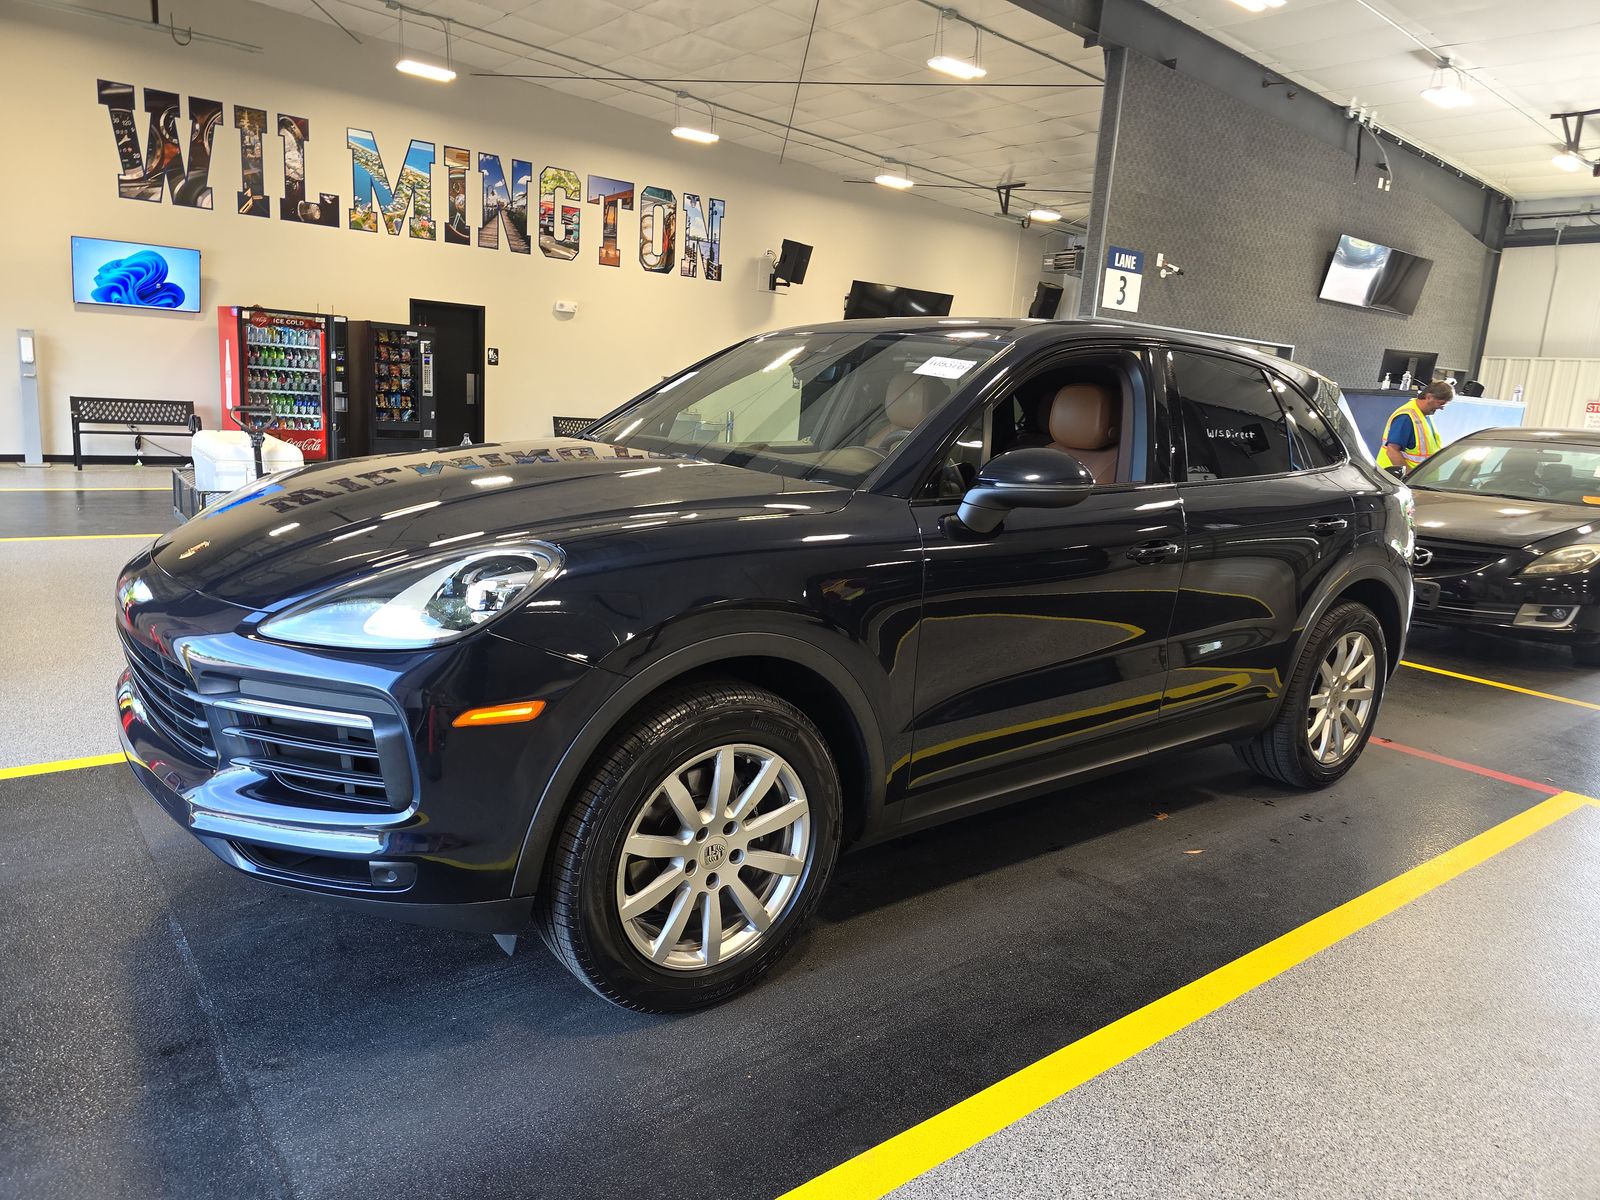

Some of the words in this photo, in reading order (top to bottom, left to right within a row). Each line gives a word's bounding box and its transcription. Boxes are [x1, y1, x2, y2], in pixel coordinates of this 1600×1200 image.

[97, 79, 725, 281] WILMINGTON
[1114, 252, 1137, 270] LANE
[1116, 275, 1127, 306] 3
